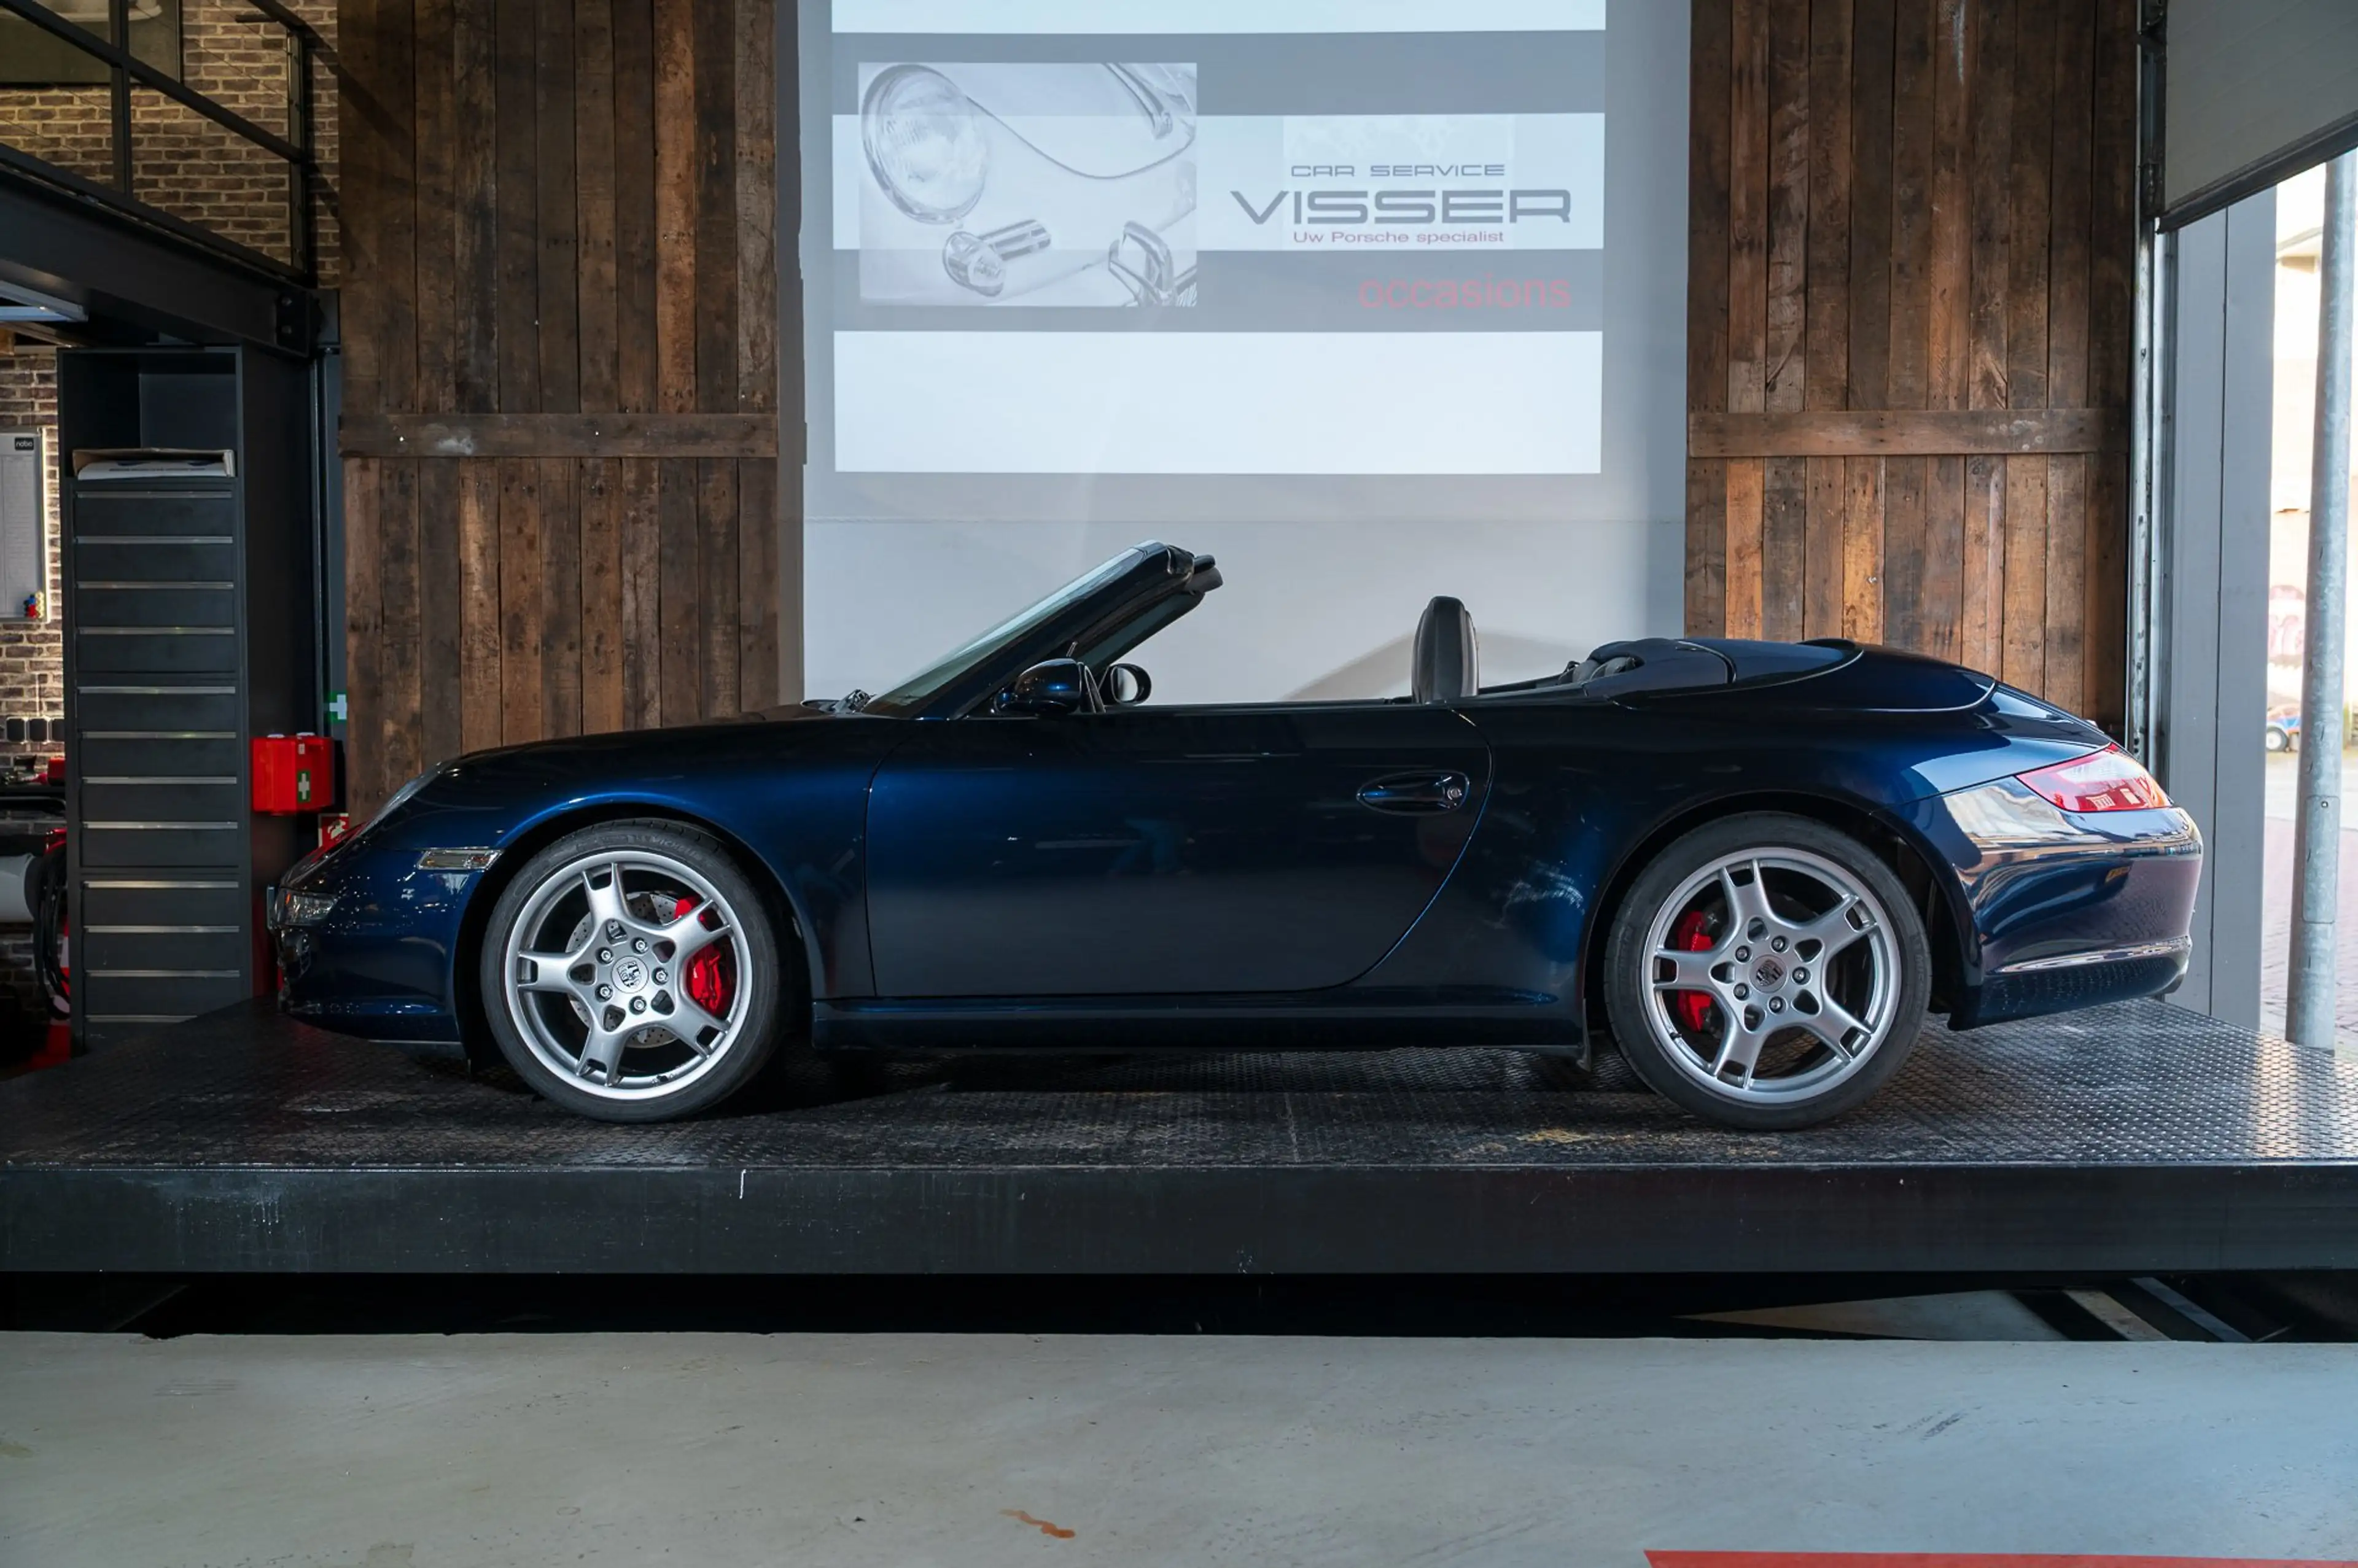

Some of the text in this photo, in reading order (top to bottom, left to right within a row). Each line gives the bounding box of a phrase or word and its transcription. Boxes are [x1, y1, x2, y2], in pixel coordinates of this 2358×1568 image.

[1291, 164, 1505, 177] CAR SERVICE
[1229, 189, 1571, 225] VISSER
[1293, 230, 1504, 245] Uw Porsche specialist
[1358, 273, 1571, 308] occasions
